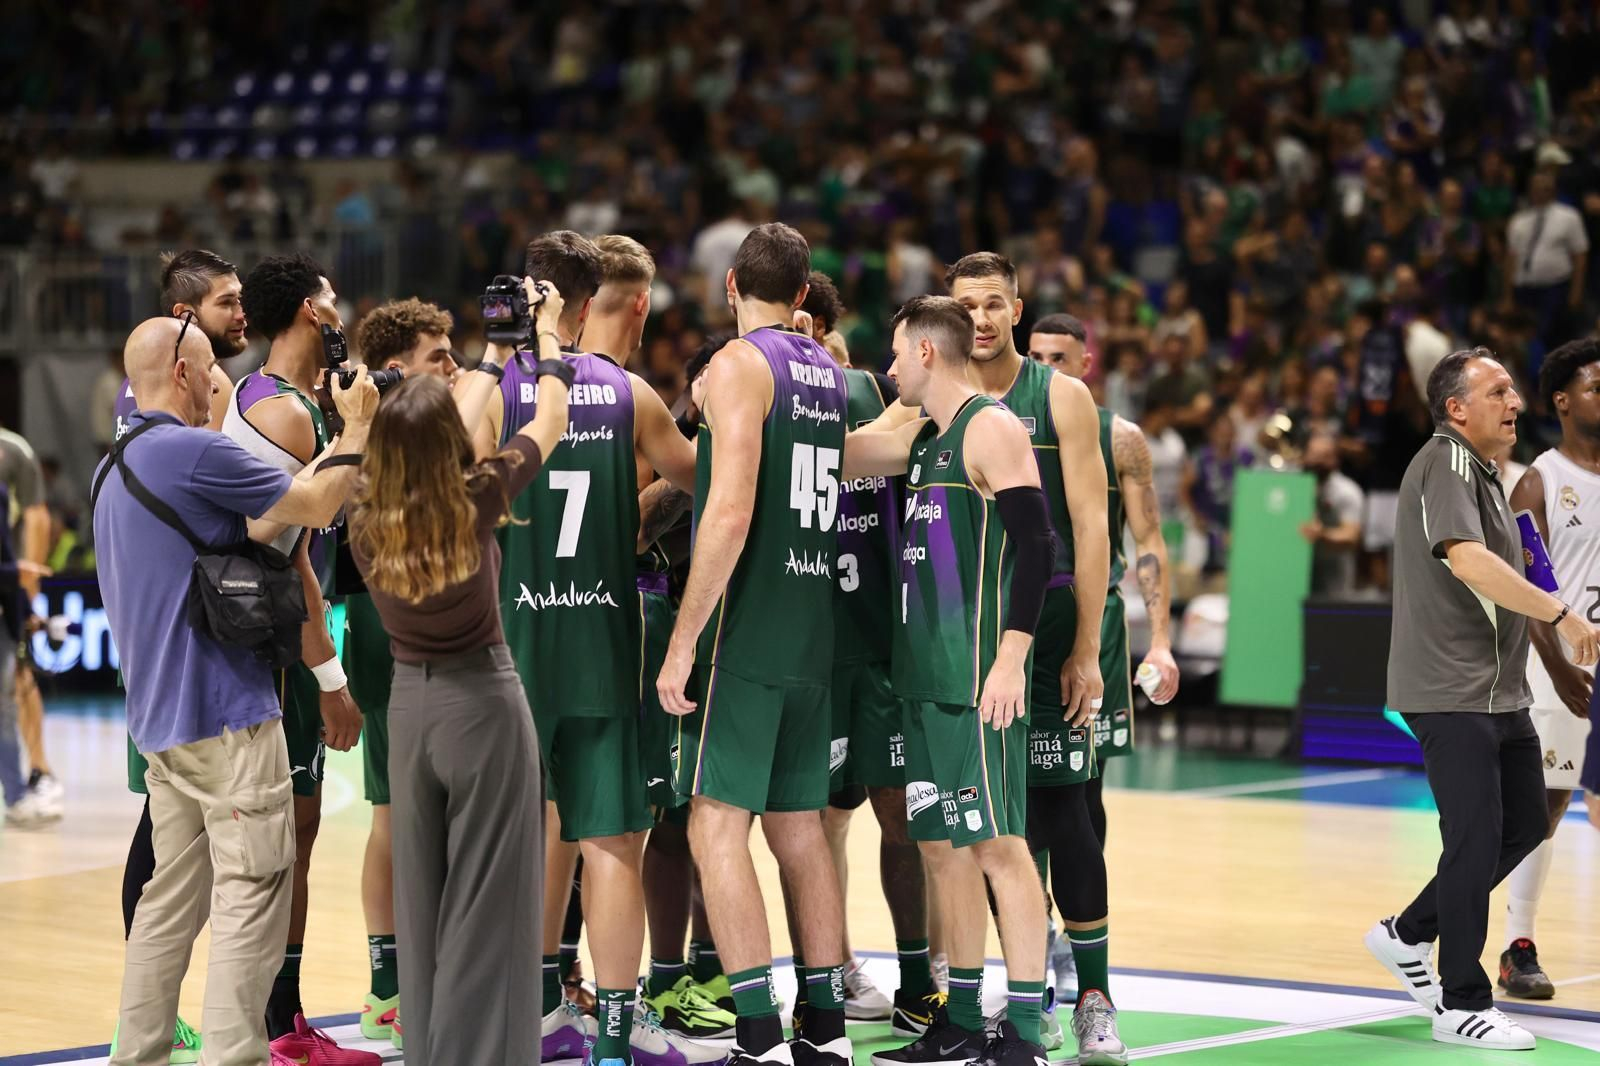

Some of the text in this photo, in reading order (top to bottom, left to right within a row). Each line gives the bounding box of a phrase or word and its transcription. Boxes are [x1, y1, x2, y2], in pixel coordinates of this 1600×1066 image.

[520, 383, 617, 405] BEIRO
[789, 441, 840, 533] 45
[839, 475, 887, 494] nicaja
[549, 470, 591, 558] 7
[837, 553, 860, 592] 3
[513, 579, 620, 611] Andalucía
[1030, 750, 1064, 769] laga
[960, 792, 974, 801] acb
